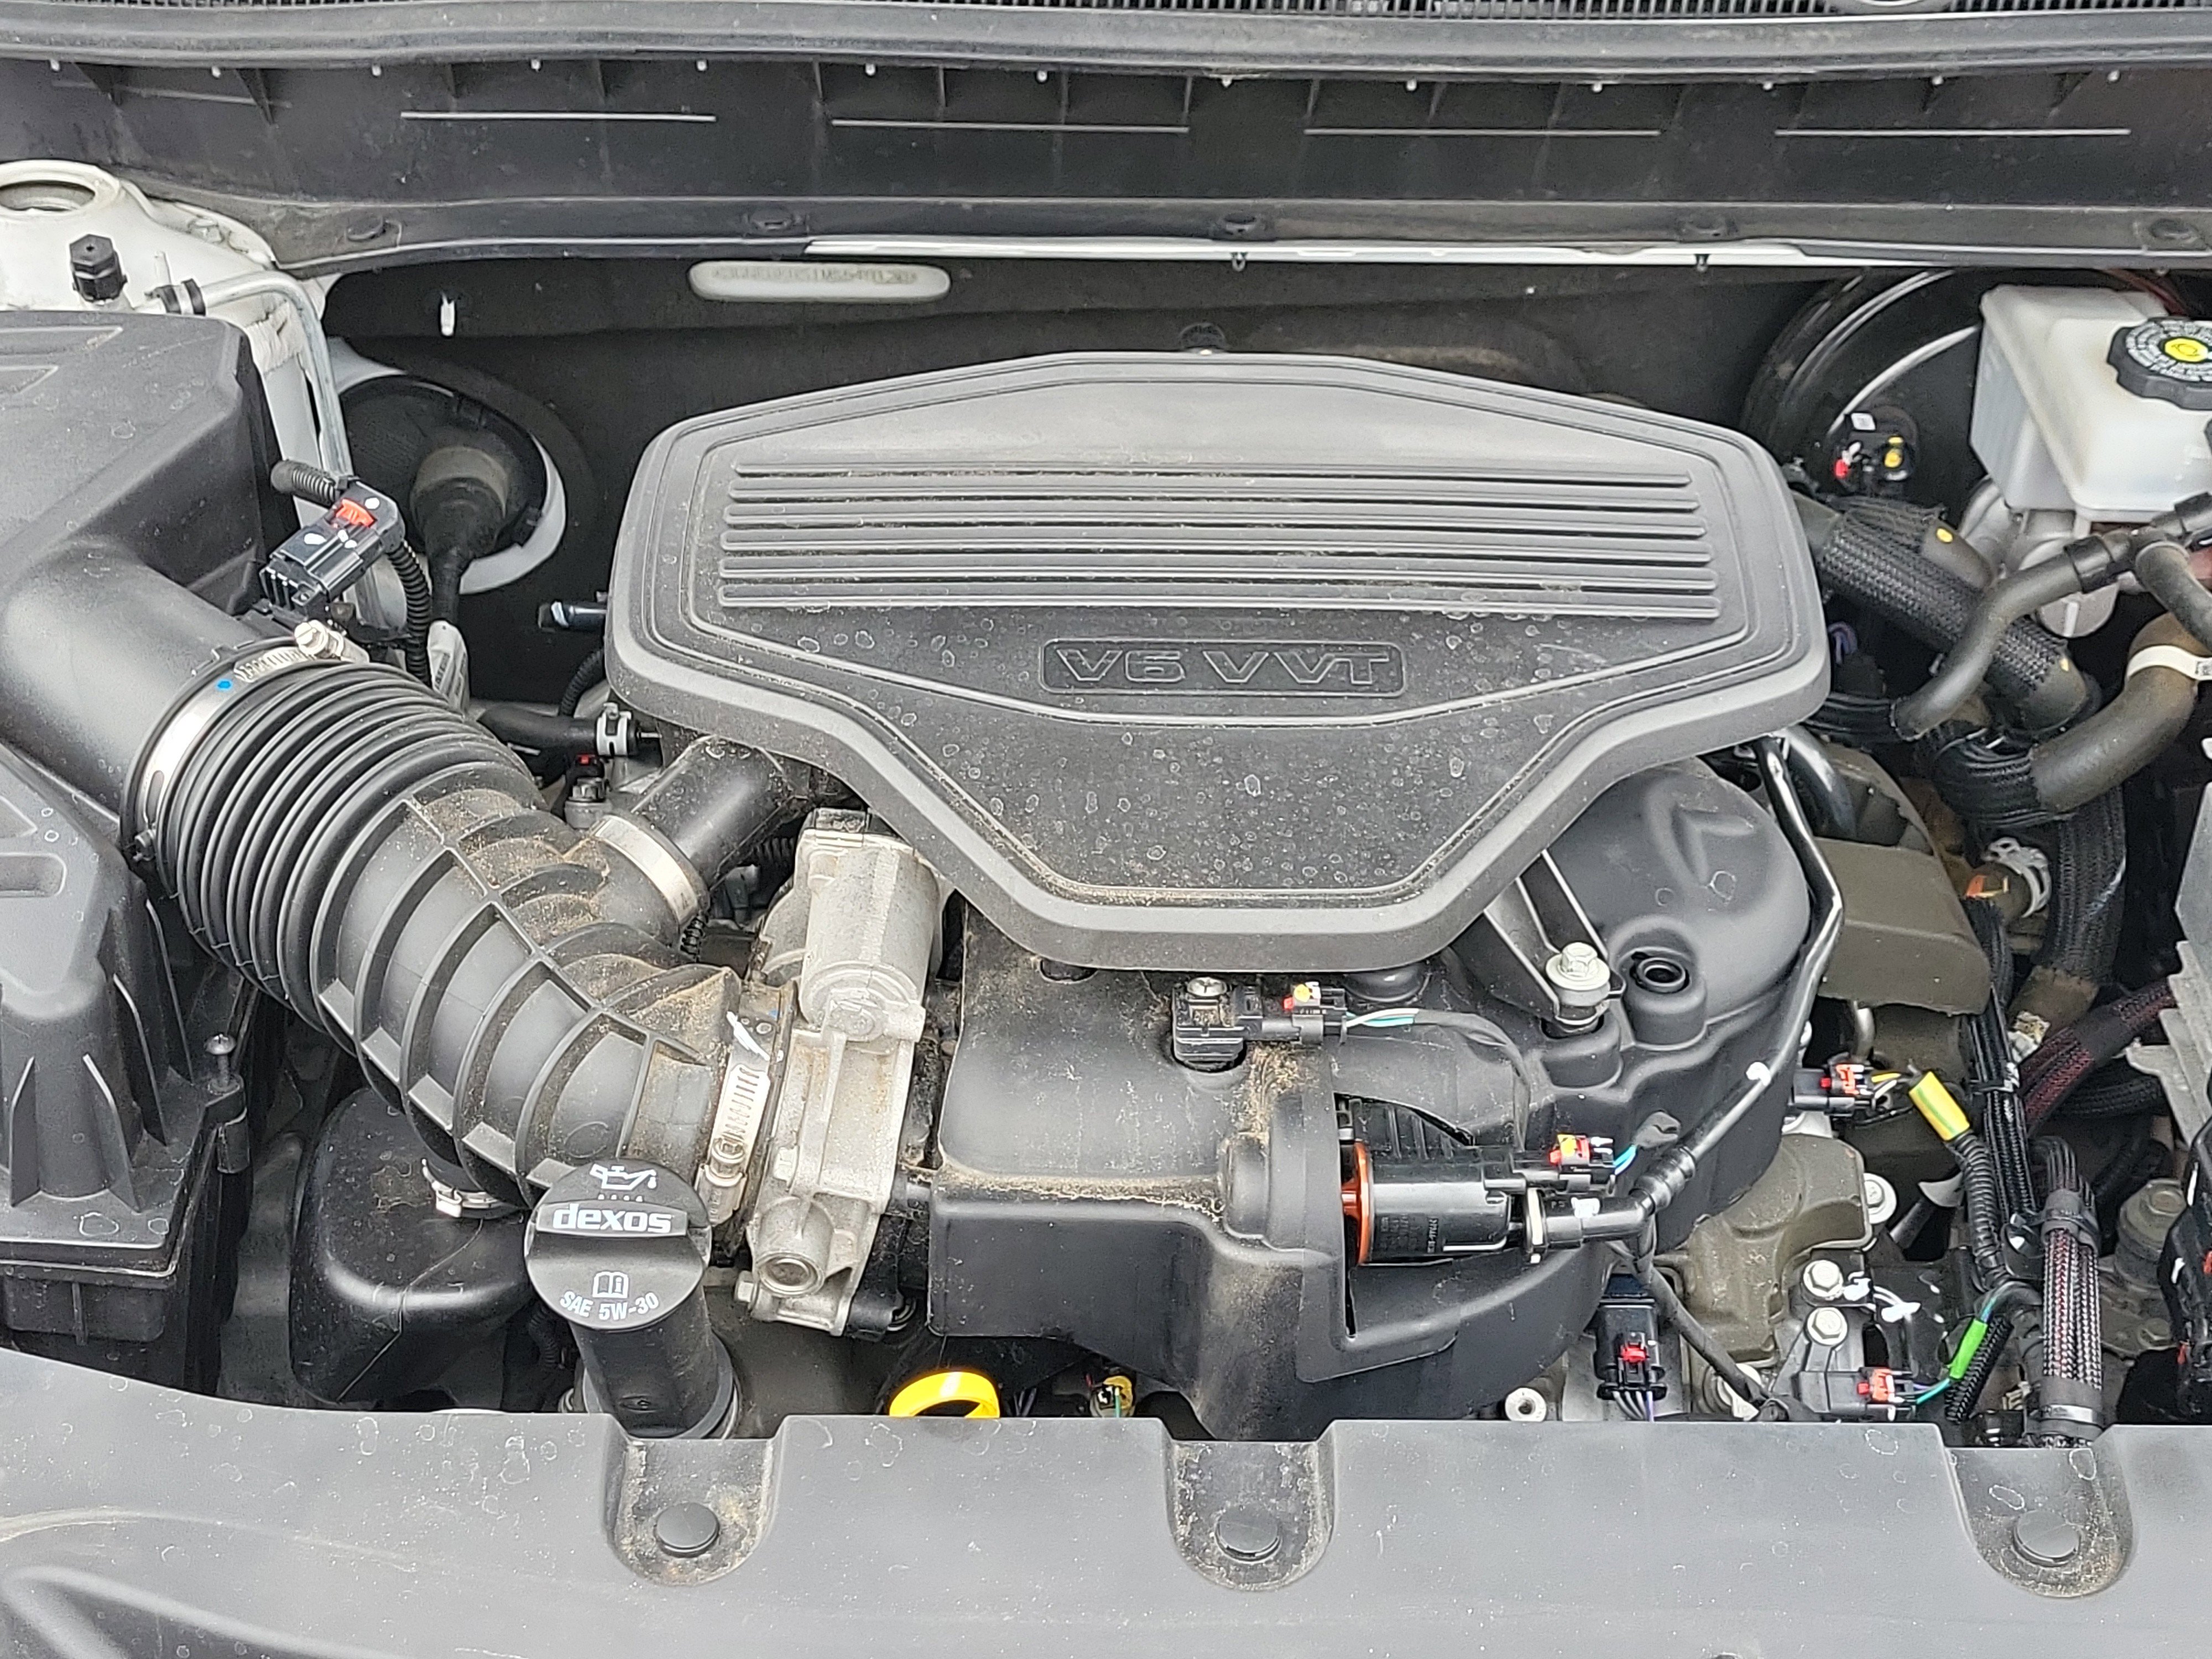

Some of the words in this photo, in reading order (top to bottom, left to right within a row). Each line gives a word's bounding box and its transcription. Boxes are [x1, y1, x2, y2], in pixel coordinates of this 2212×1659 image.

[1055, 649, 1186, 682] V6
[1202, 649, 1390, 685] VVT
[553, 1204, 672, 1233] dexos
[560, 1290, 593, 1318] SAE
[599, 1291, 659, 1321] 5W-30
